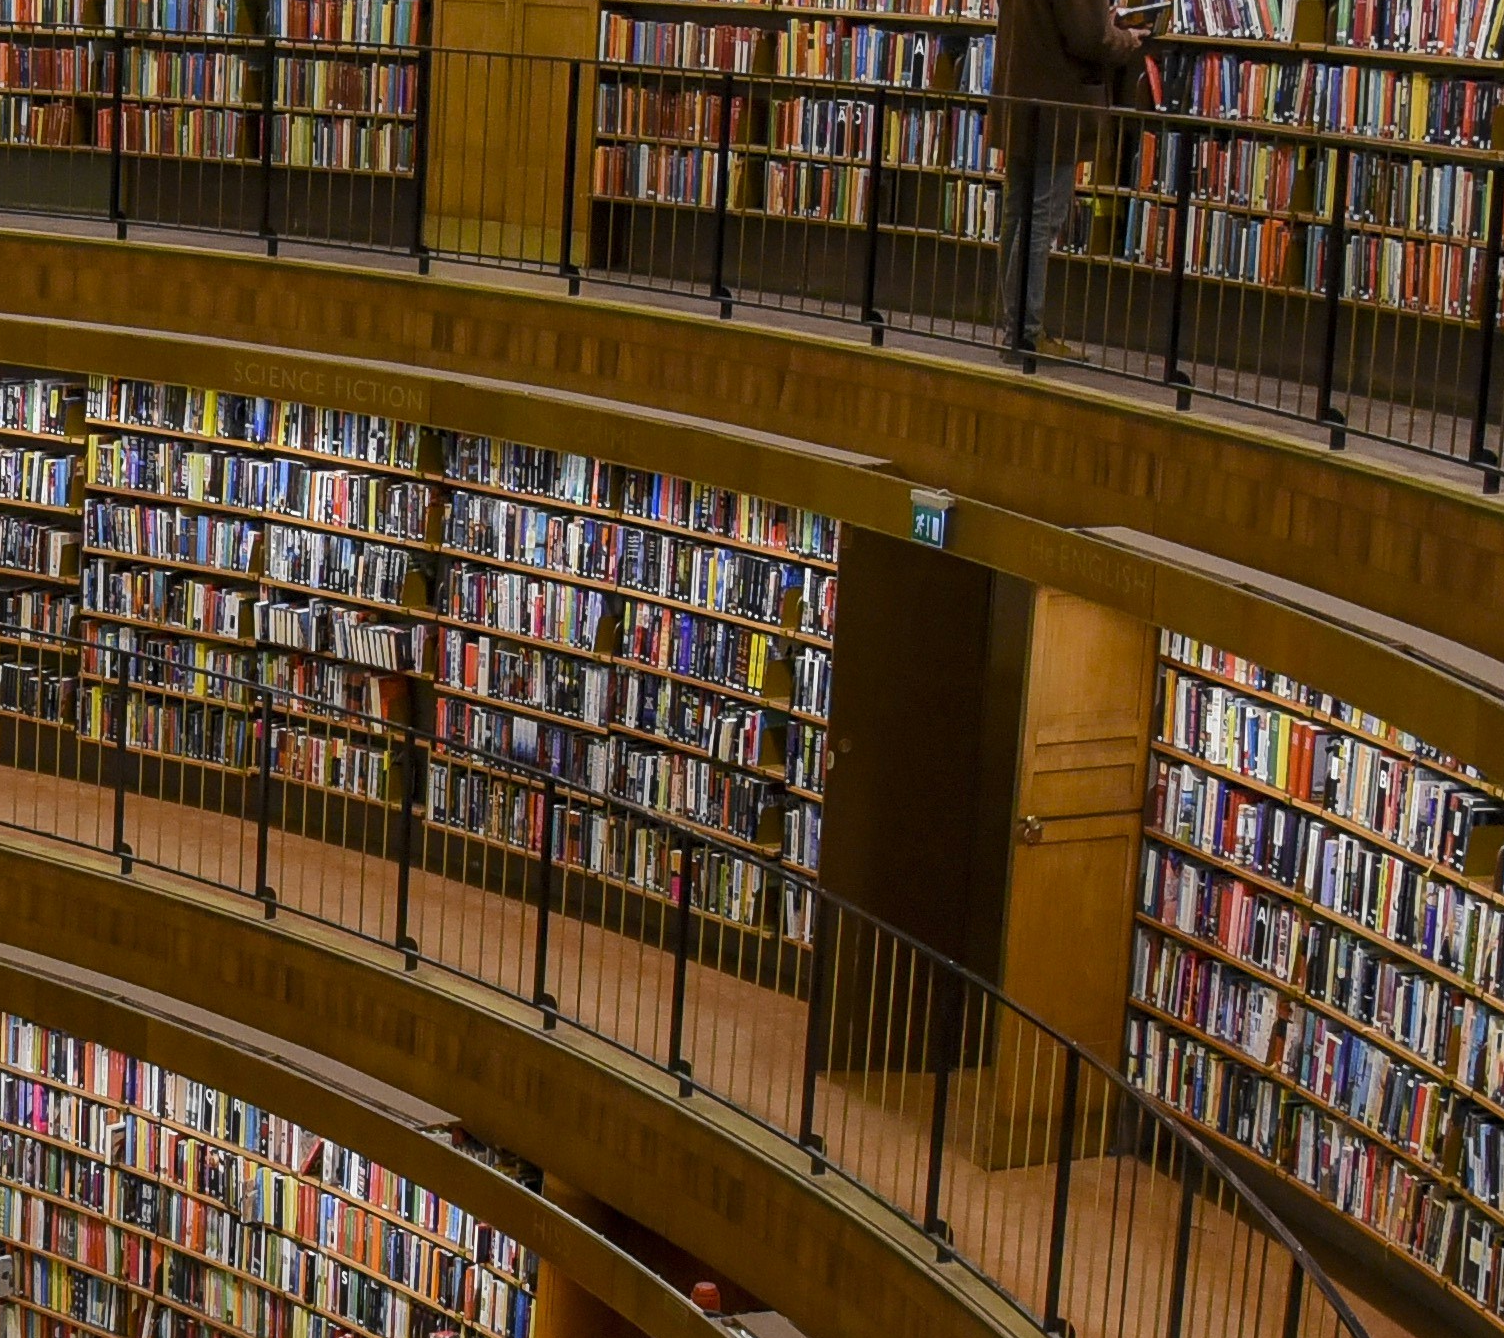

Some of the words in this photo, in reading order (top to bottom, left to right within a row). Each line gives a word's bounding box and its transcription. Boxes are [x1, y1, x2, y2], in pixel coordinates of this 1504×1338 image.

[233, 359, 326, 395] SCIENCE
[334, 375, 424, 411] FICTION
[1380, 769, 1388, 789] B
[1257, 906, 1268, 926] A
[205, 1088, 215, 1105] Q
[233, 1098, 241, 1113] R
[341, 1271, 348, 1285] S
